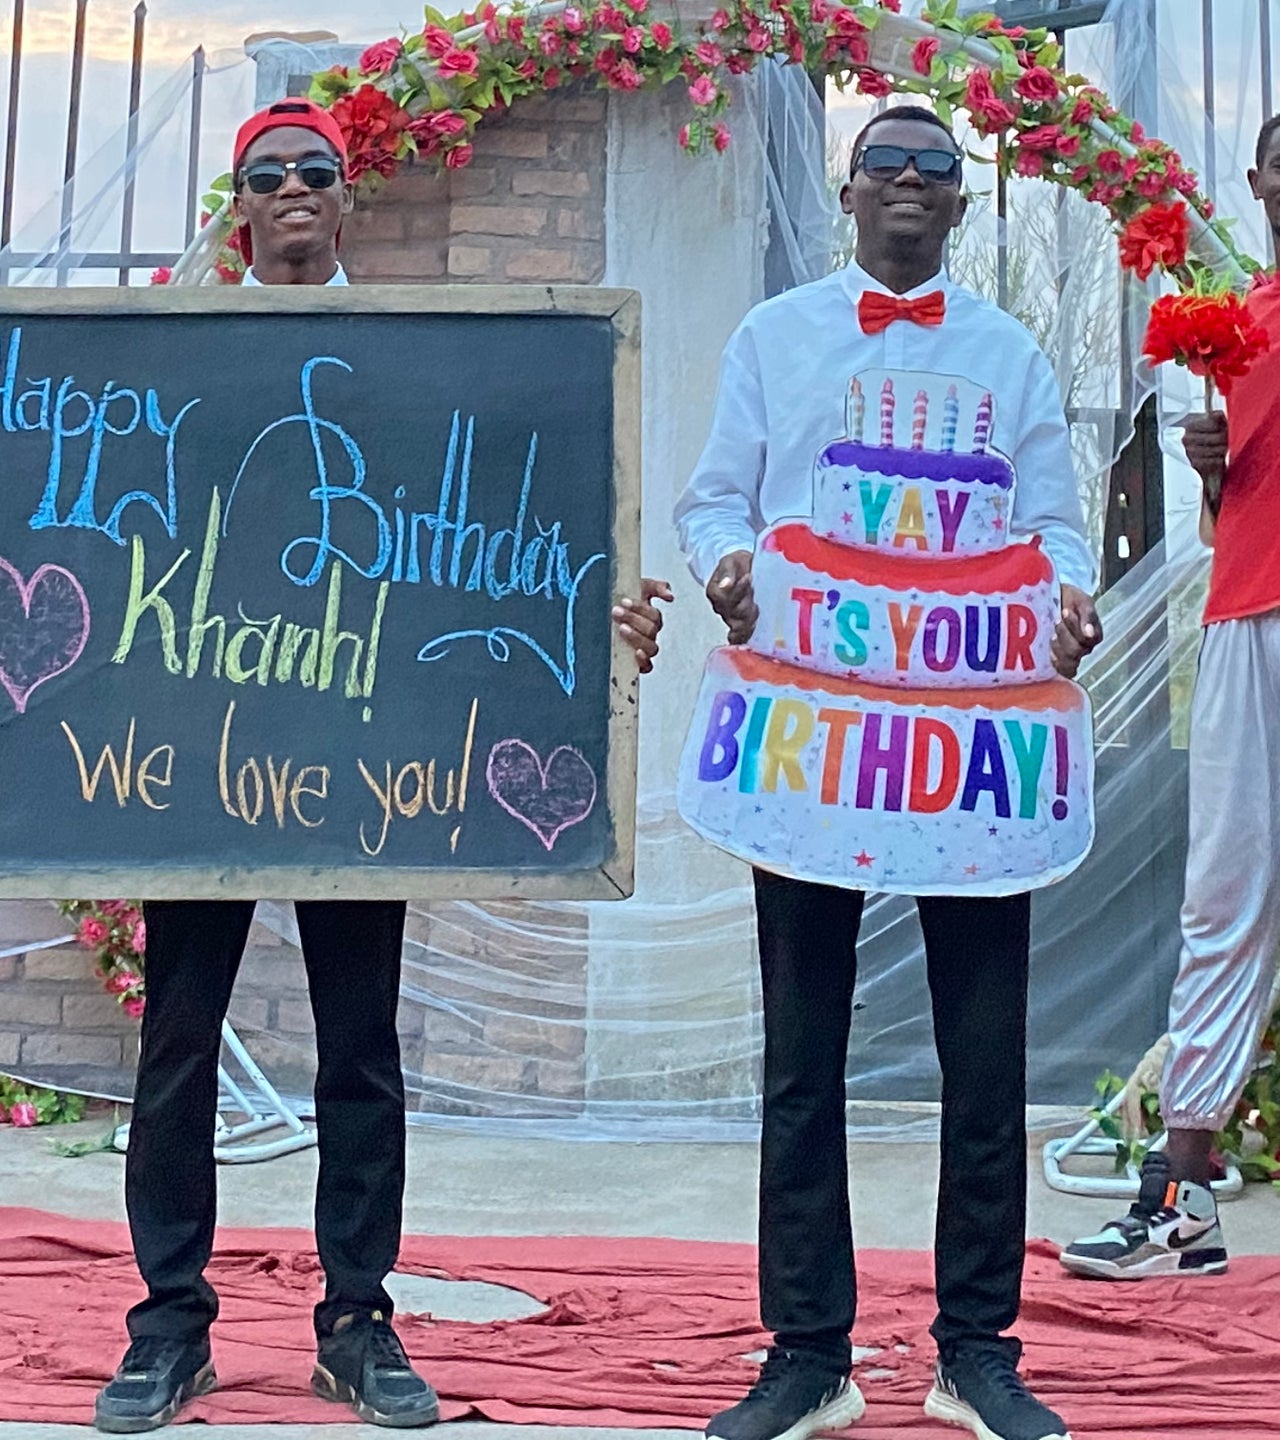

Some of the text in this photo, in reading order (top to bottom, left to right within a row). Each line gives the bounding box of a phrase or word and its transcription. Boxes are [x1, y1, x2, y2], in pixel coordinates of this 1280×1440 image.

[222, 356, 607, 698] Birthday
[858, 480, 972, 553] YAY
[773, 587, 1039, 674] T'S YOUR
[219, 699, 330, 829] love
[357, 697, 478, 856] you!
[697, 690, 1070, 823] BIRTHDAY!
